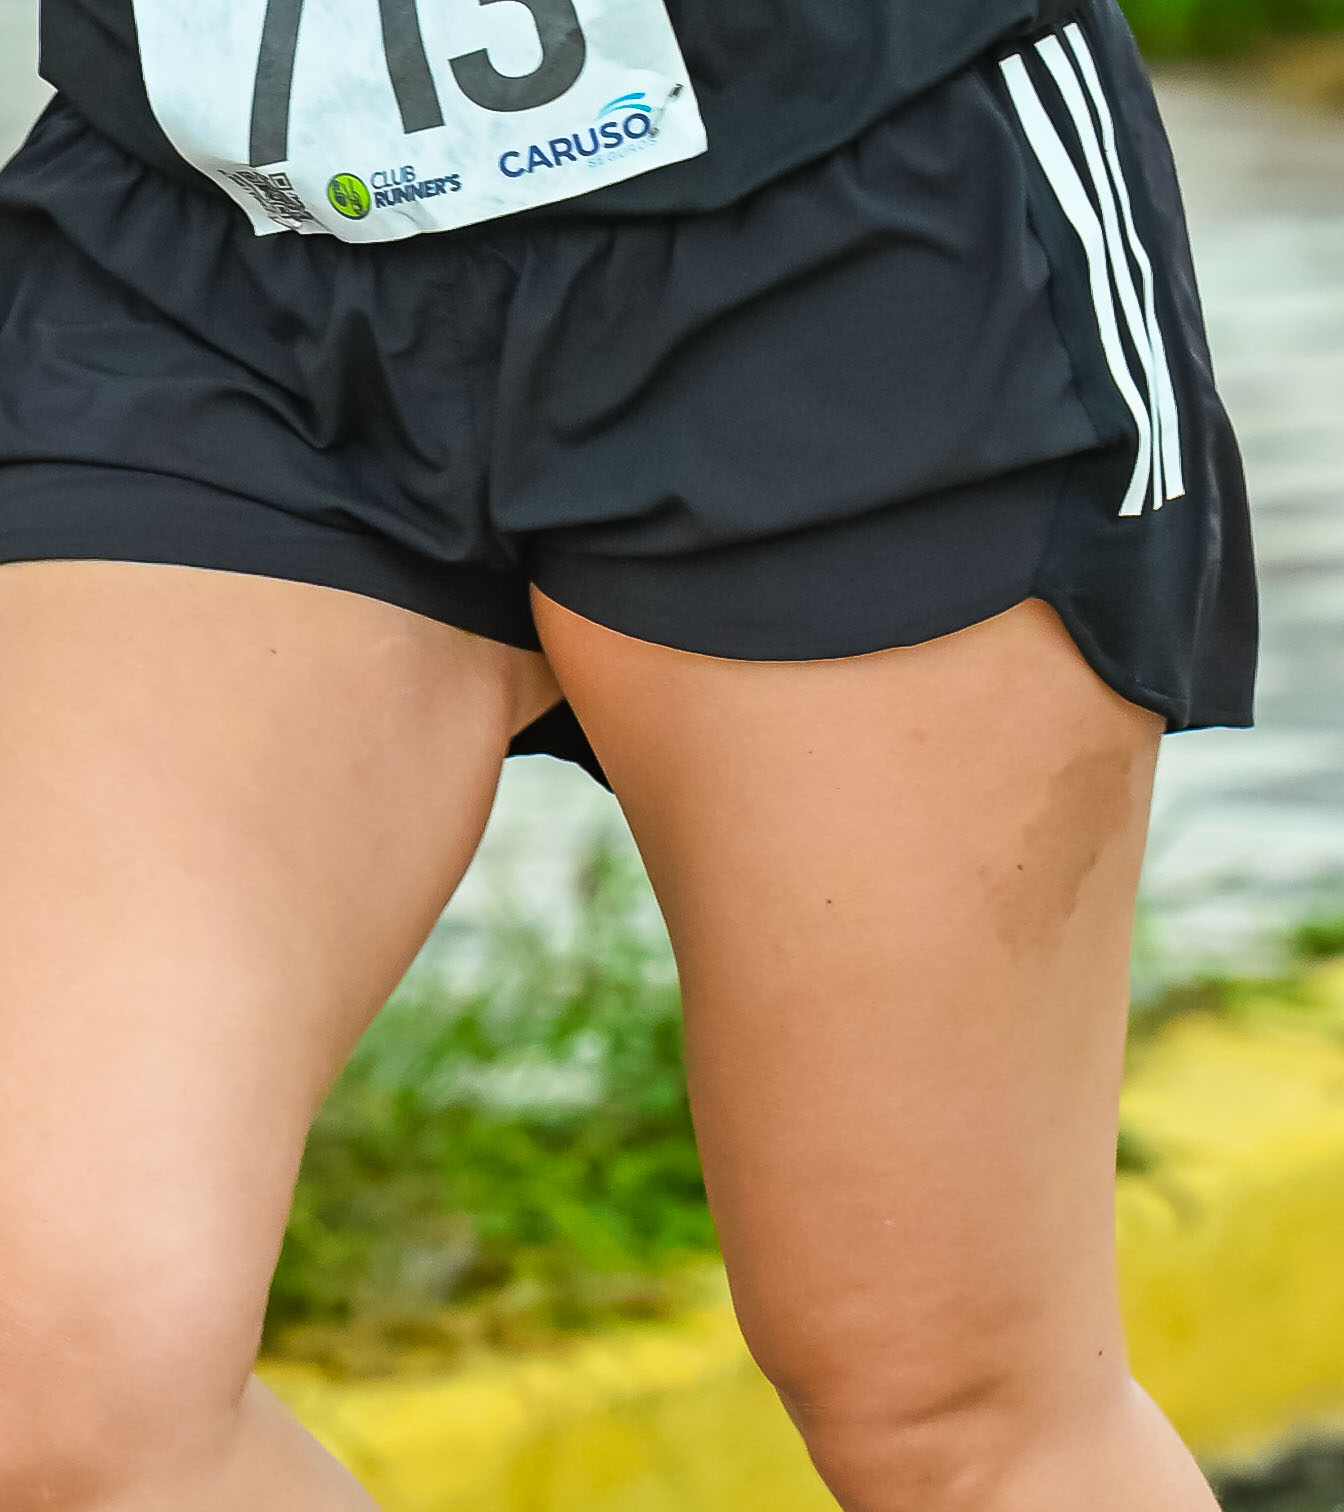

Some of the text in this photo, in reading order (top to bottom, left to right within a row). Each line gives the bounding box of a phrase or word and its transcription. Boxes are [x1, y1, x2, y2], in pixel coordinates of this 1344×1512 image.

[498, 113, 651, 178] CARUSO
[370, 165, 416, 189] CLUB
[373, 174, 462, 208] RUNNER'S
